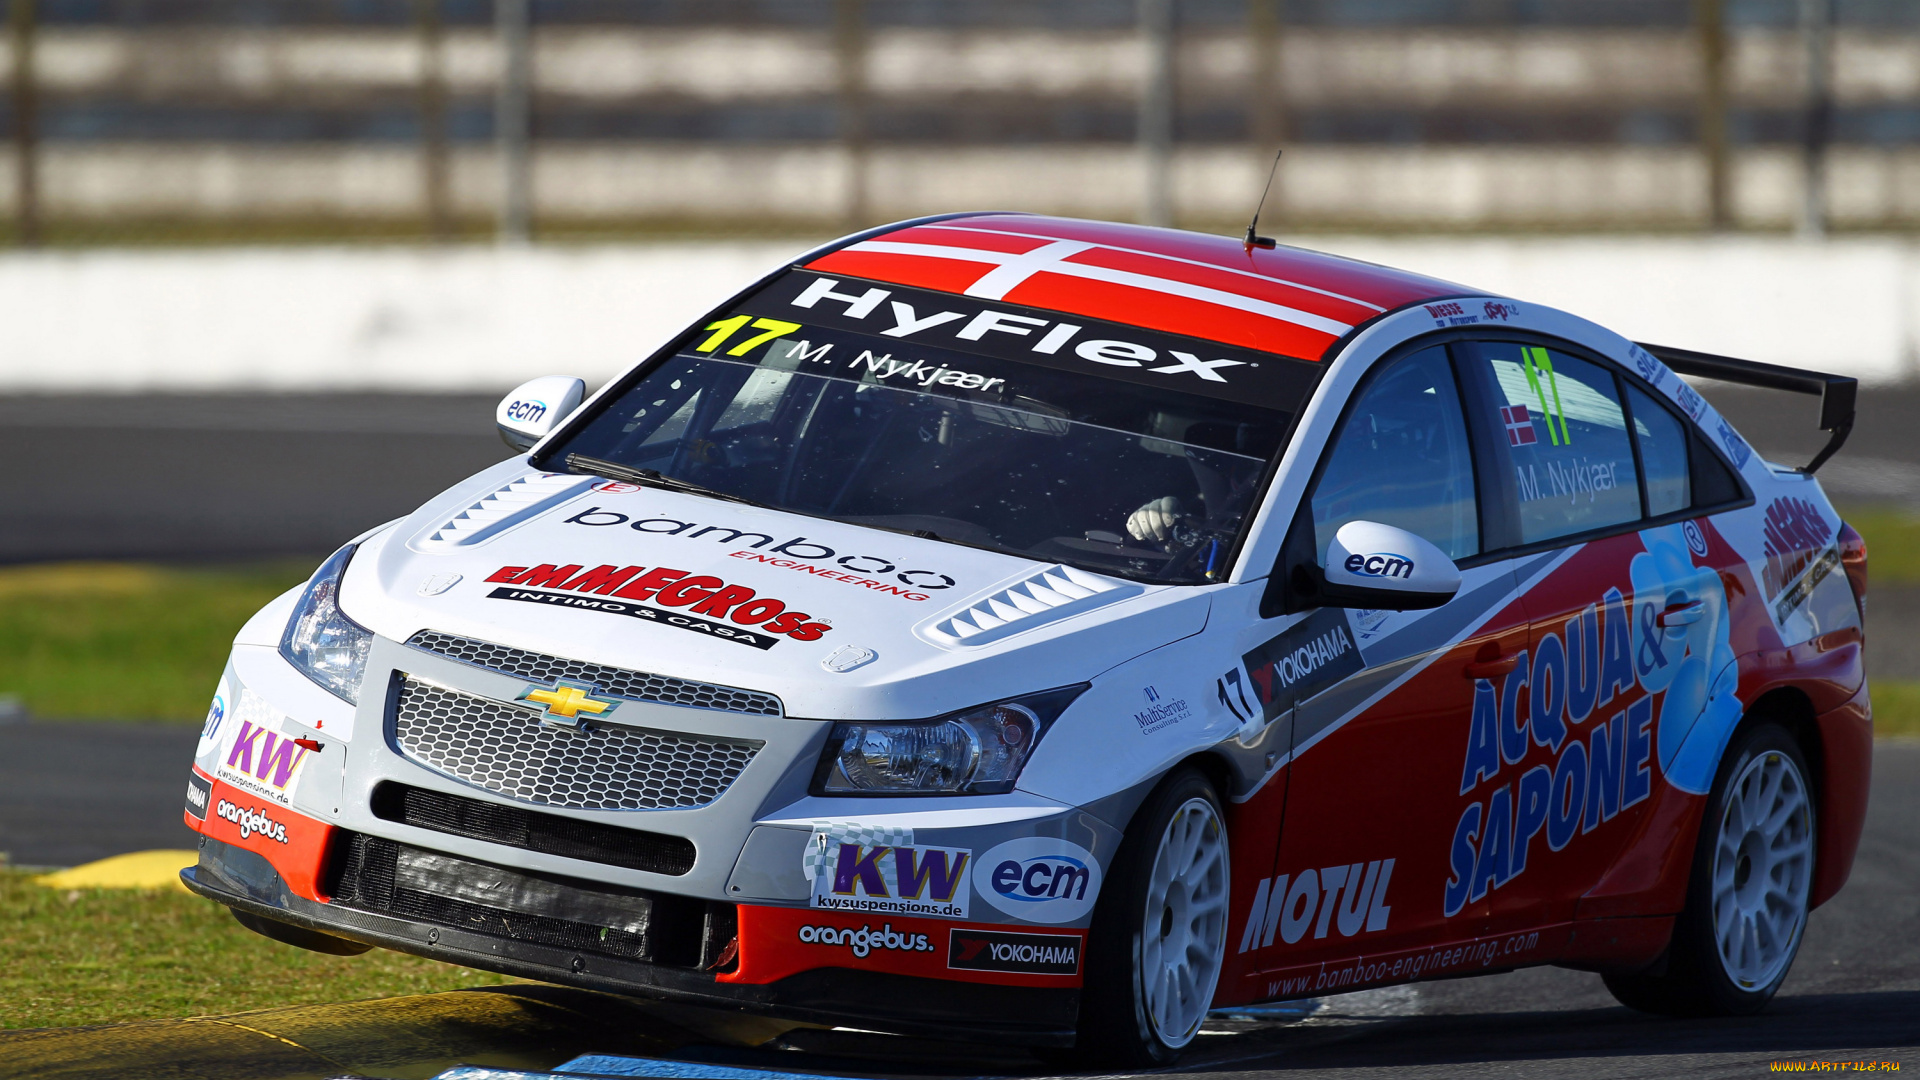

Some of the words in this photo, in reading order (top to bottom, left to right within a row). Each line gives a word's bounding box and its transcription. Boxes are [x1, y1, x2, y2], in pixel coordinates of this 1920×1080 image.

[695, 315, 802, 358] 17
[790, 277, 1242, 384] HyFlex
[783, 339, 832, 365] M.
[848, 349, 1006, 392] Nykjær
[507, 400, 547, 423] ecm
[1517, 463, 1546, 502] M.
[1548, 457, 1617, 505] Nykjær
[563, 506, 956, 591] bamboo
[1344, 553, 1415, 579] ecm
[728, 550, 930, 602] ENGINEERING
[508, 591, 627, 612] INTIMO
[634, 609, 657, 619] &
[667, 616, 757, 644] CASA
[1274, 625, 1352, 688] YOKOHAMA
[1134, 697, 1188, 729] MultiService
[1217, 667, 1255, 725] 17
[1459, 587, 1635, 796] ACQUA
[1636, 601, 1669, 677] &
[1142, 714, 1179, 736] Consulting
[227, 719, 309, 791] KW
[1444, 694, 1653, 918] SAPONE
[832, 843, 971, 902] KW
[991, 859, 1091, 901] ecm
[817, 895, 963, 917] kwsuspensions.de
[1238, 858, 1396, 955] MOTUL
[989, 942, 1076, 964] YOKOHAMA
[1267, 929, 1540, 998] www.bamboo-engineering.com
